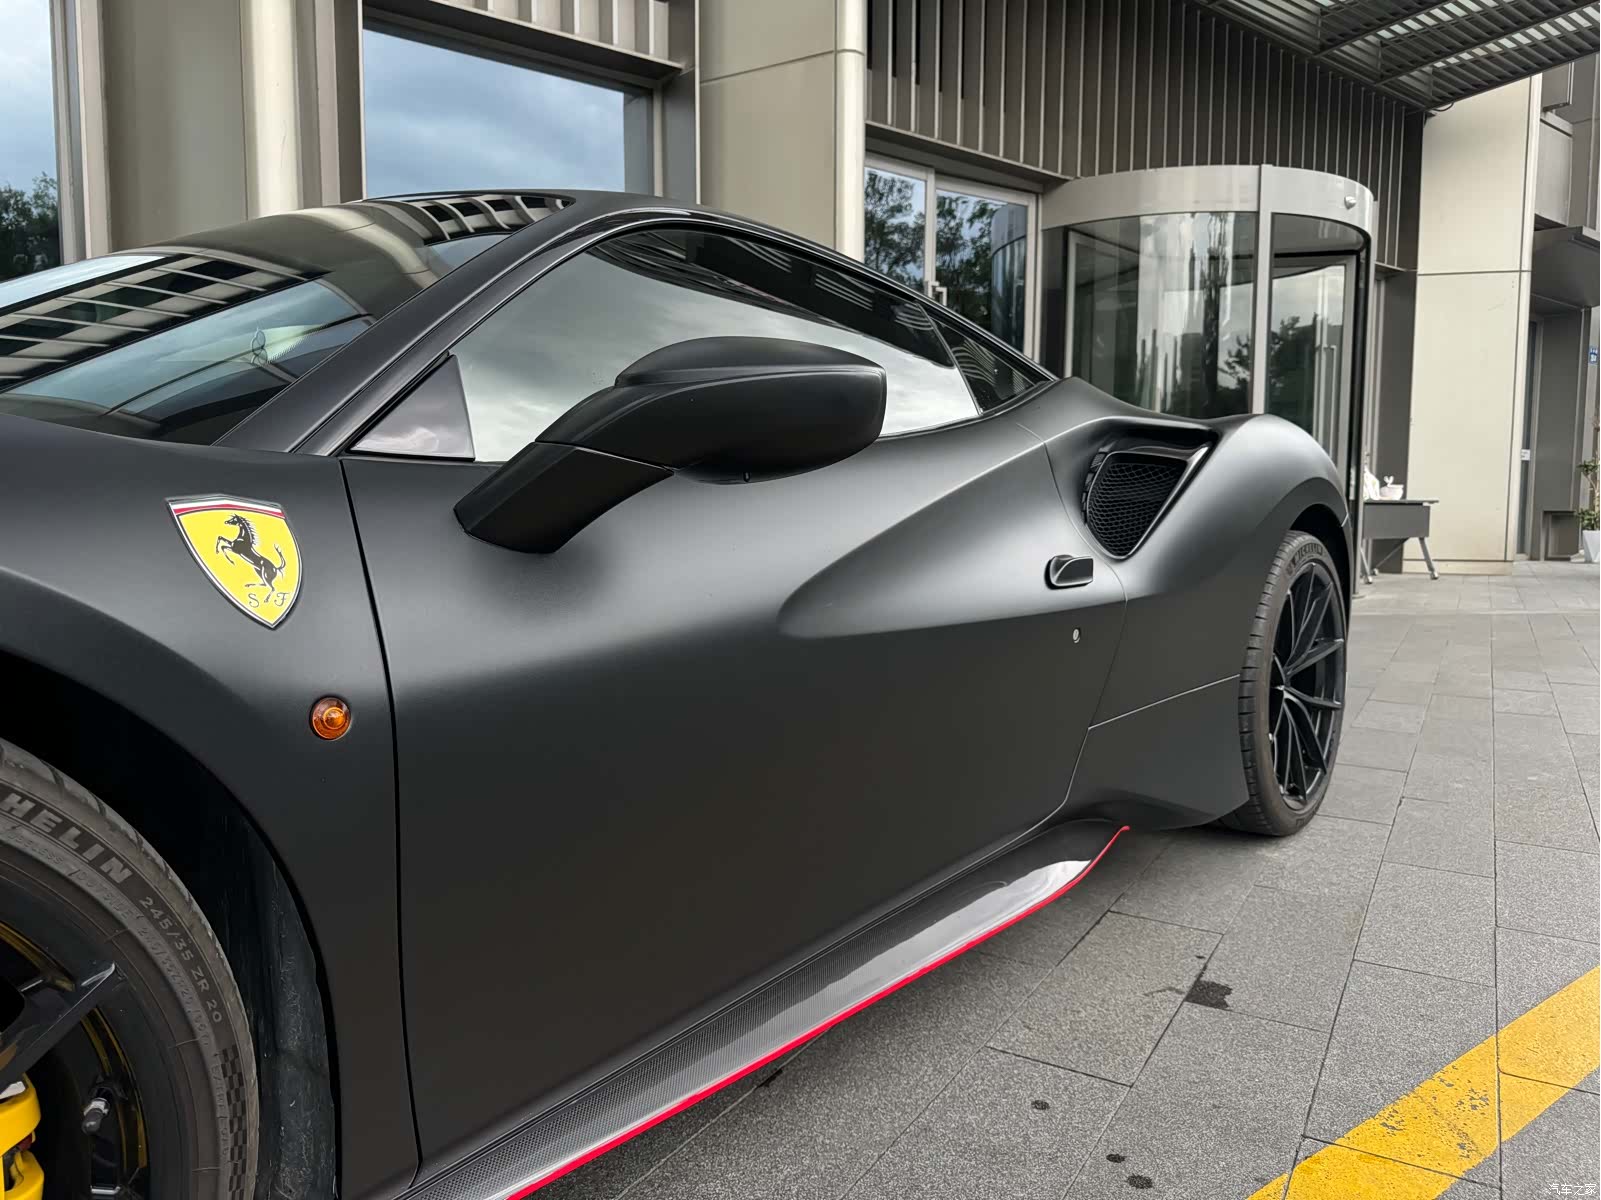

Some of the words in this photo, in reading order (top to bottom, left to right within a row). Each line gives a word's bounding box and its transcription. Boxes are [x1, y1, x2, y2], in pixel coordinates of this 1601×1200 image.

[248, 593, 260, 608] S
[274, 592, 290, 607] F
[0, 792, 134, 884] HELIN
[139, 896, 195, 962] 245/35
[191, 966, 210, 993] ZR
[206, 1000, 223, 1023] 20
